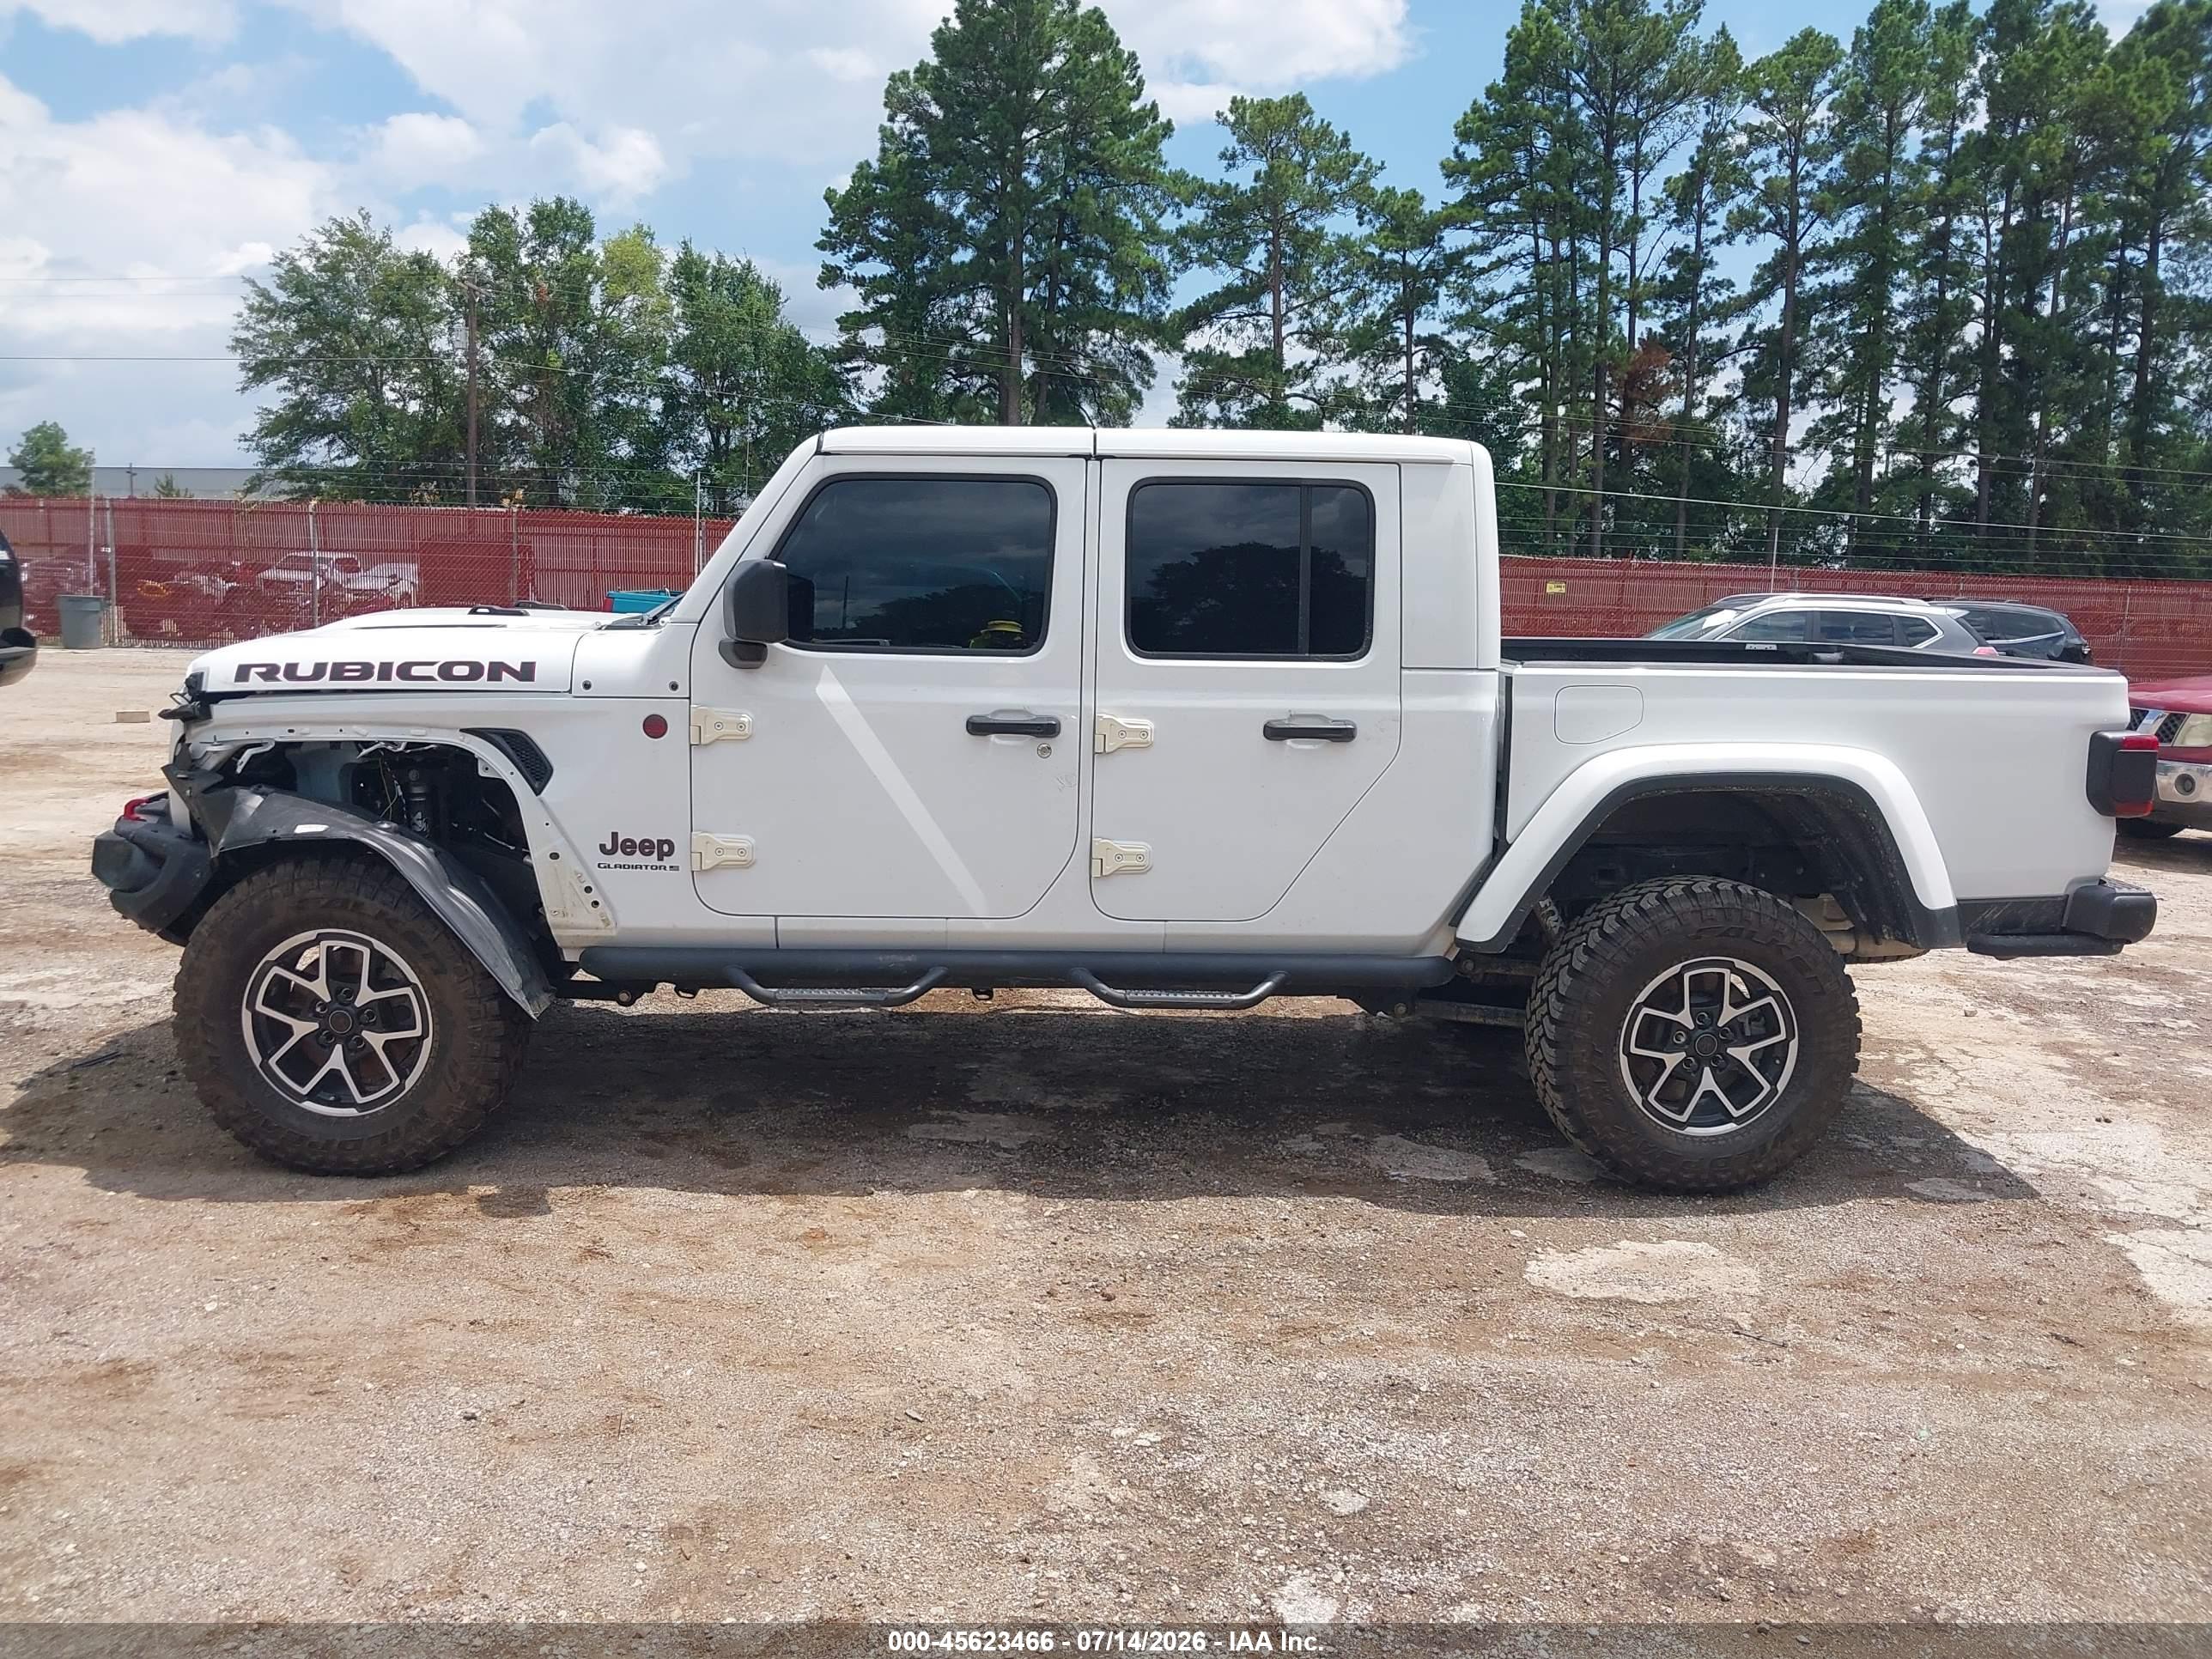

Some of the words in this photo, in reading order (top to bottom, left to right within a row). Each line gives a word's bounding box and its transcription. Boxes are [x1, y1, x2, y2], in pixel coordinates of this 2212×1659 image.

[234, 660, 537, 684] RUBICON
[599, 831, 675, 861] Jeep
[597, 862, 667, 872] GLADIATOR
